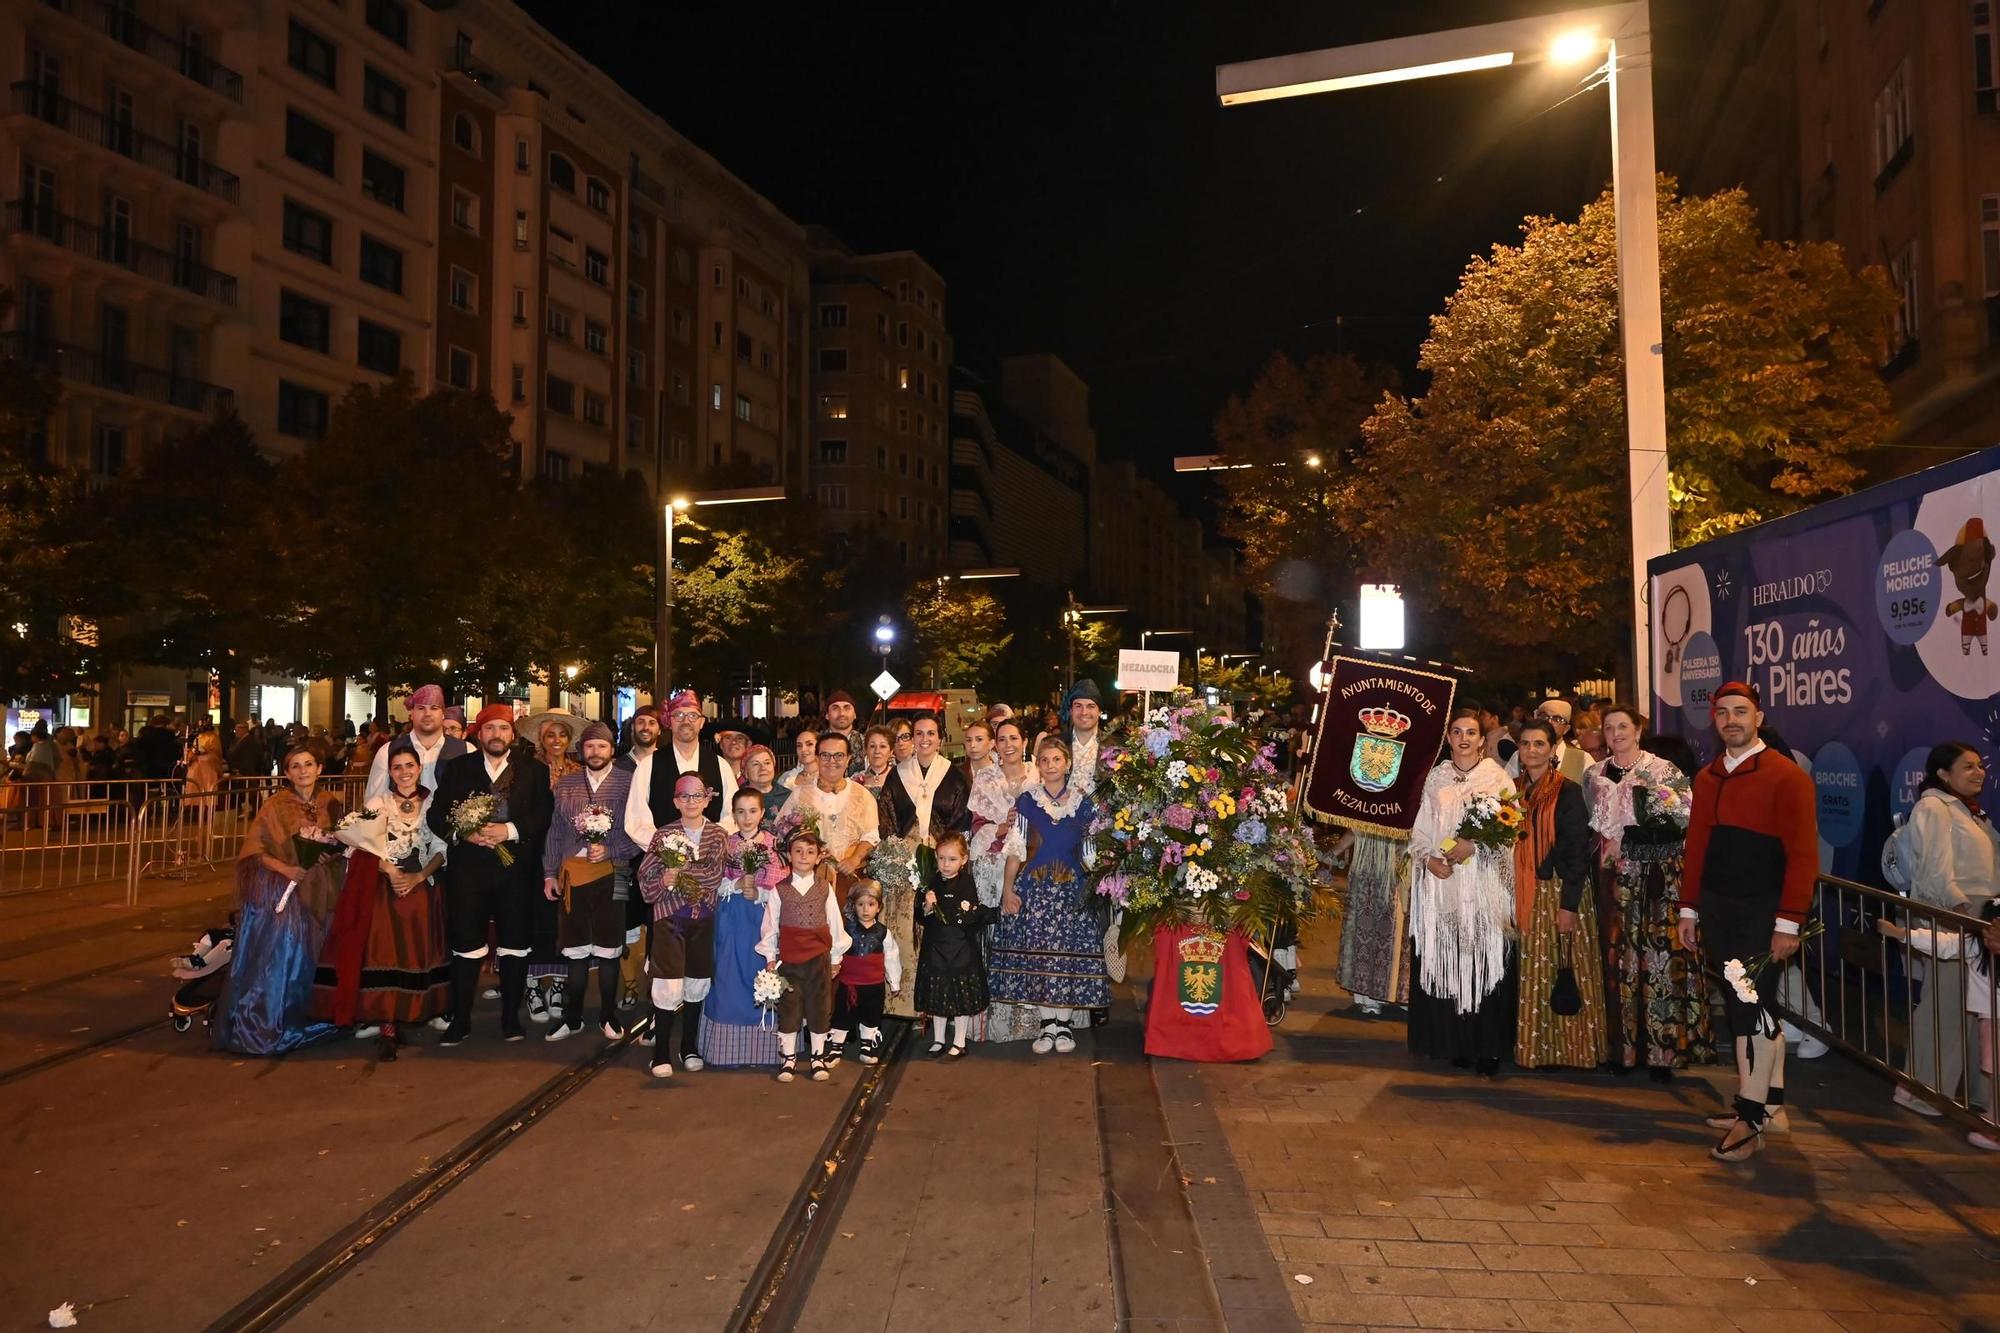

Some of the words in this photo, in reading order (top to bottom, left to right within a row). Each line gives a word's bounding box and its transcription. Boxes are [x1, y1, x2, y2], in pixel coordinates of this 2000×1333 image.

[1883, 554, 1932, 578] PELUCHE
[1753, 573, 1815, 607] HERALDO
[1886, 572, 1930, 593] MORICO
[1891, 598, 1927, 620] 9,95€
[1744, 621, 1784, 665] 130
[1792, 619, 1845, 660] años
[1121, 662, 1175, 673] MEZALOCHA
[1681, 667, 1720, 680] ANIVERSARIO
[1769, 662, 1852, 707] Pilares
[1341, 677, 1426, 702] AYUNTAMIENTO
[1421, 699, 1436, 716] DE
[1816, 771, 1857, 787] BROCHE
[1332, 788, 1402, 815] MEZALOCHA
[1899, 788, 1915, 803] LA
